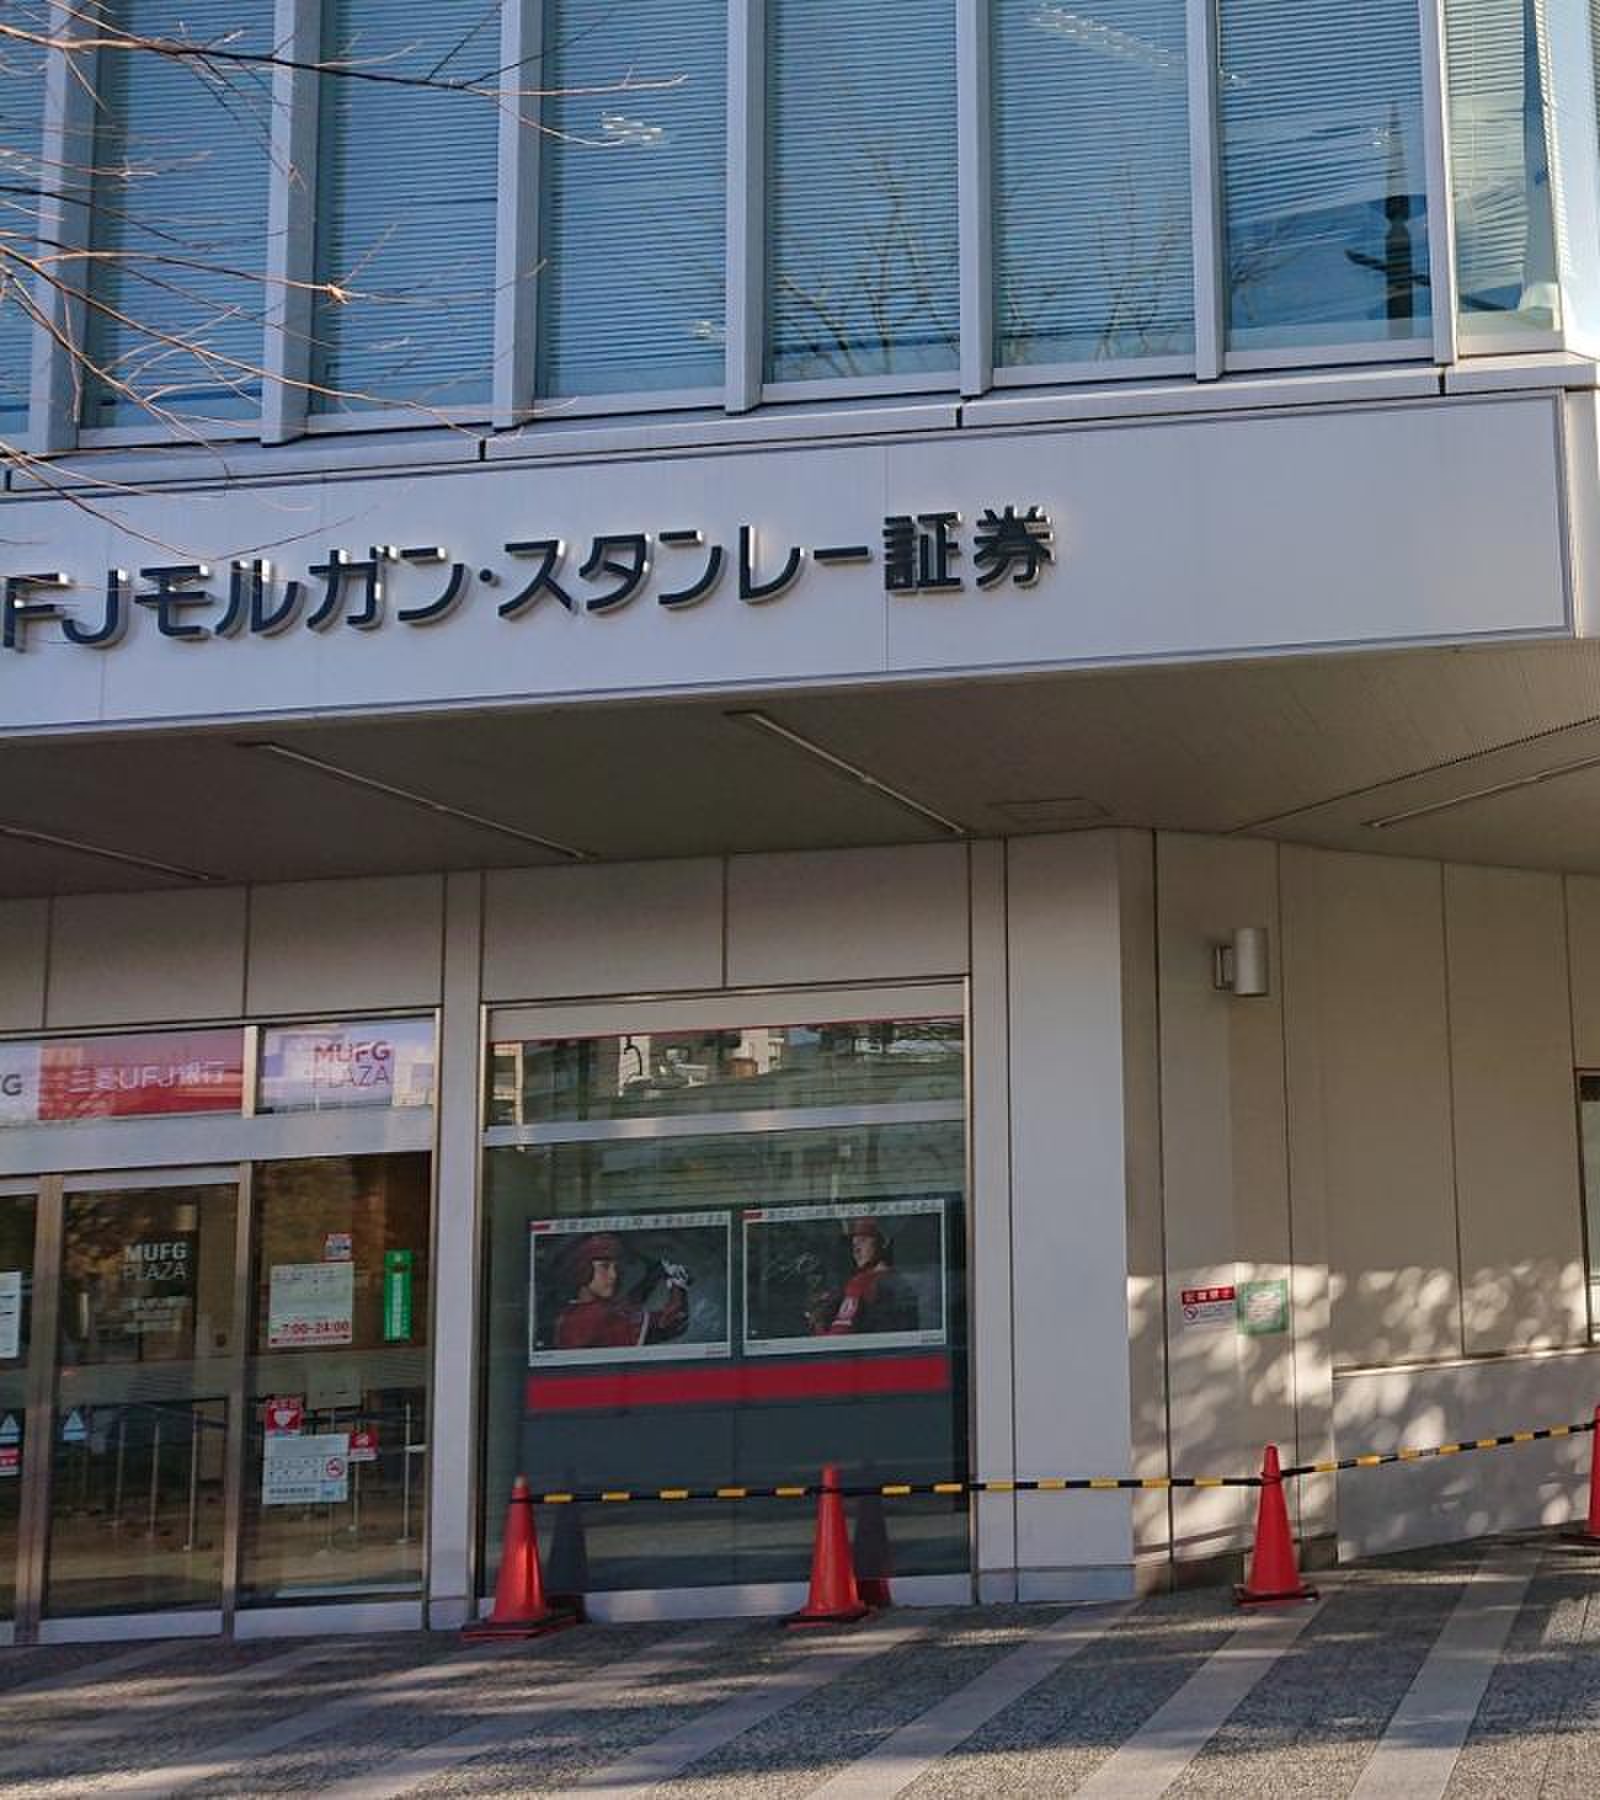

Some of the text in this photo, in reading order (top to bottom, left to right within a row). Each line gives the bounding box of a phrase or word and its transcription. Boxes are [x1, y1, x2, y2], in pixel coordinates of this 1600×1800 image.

[314, 1040, 391, 1063] MUFG
[124, 1240, 188, 1262] MUFG
[122, 1262, 187, 1281] PLAZA
